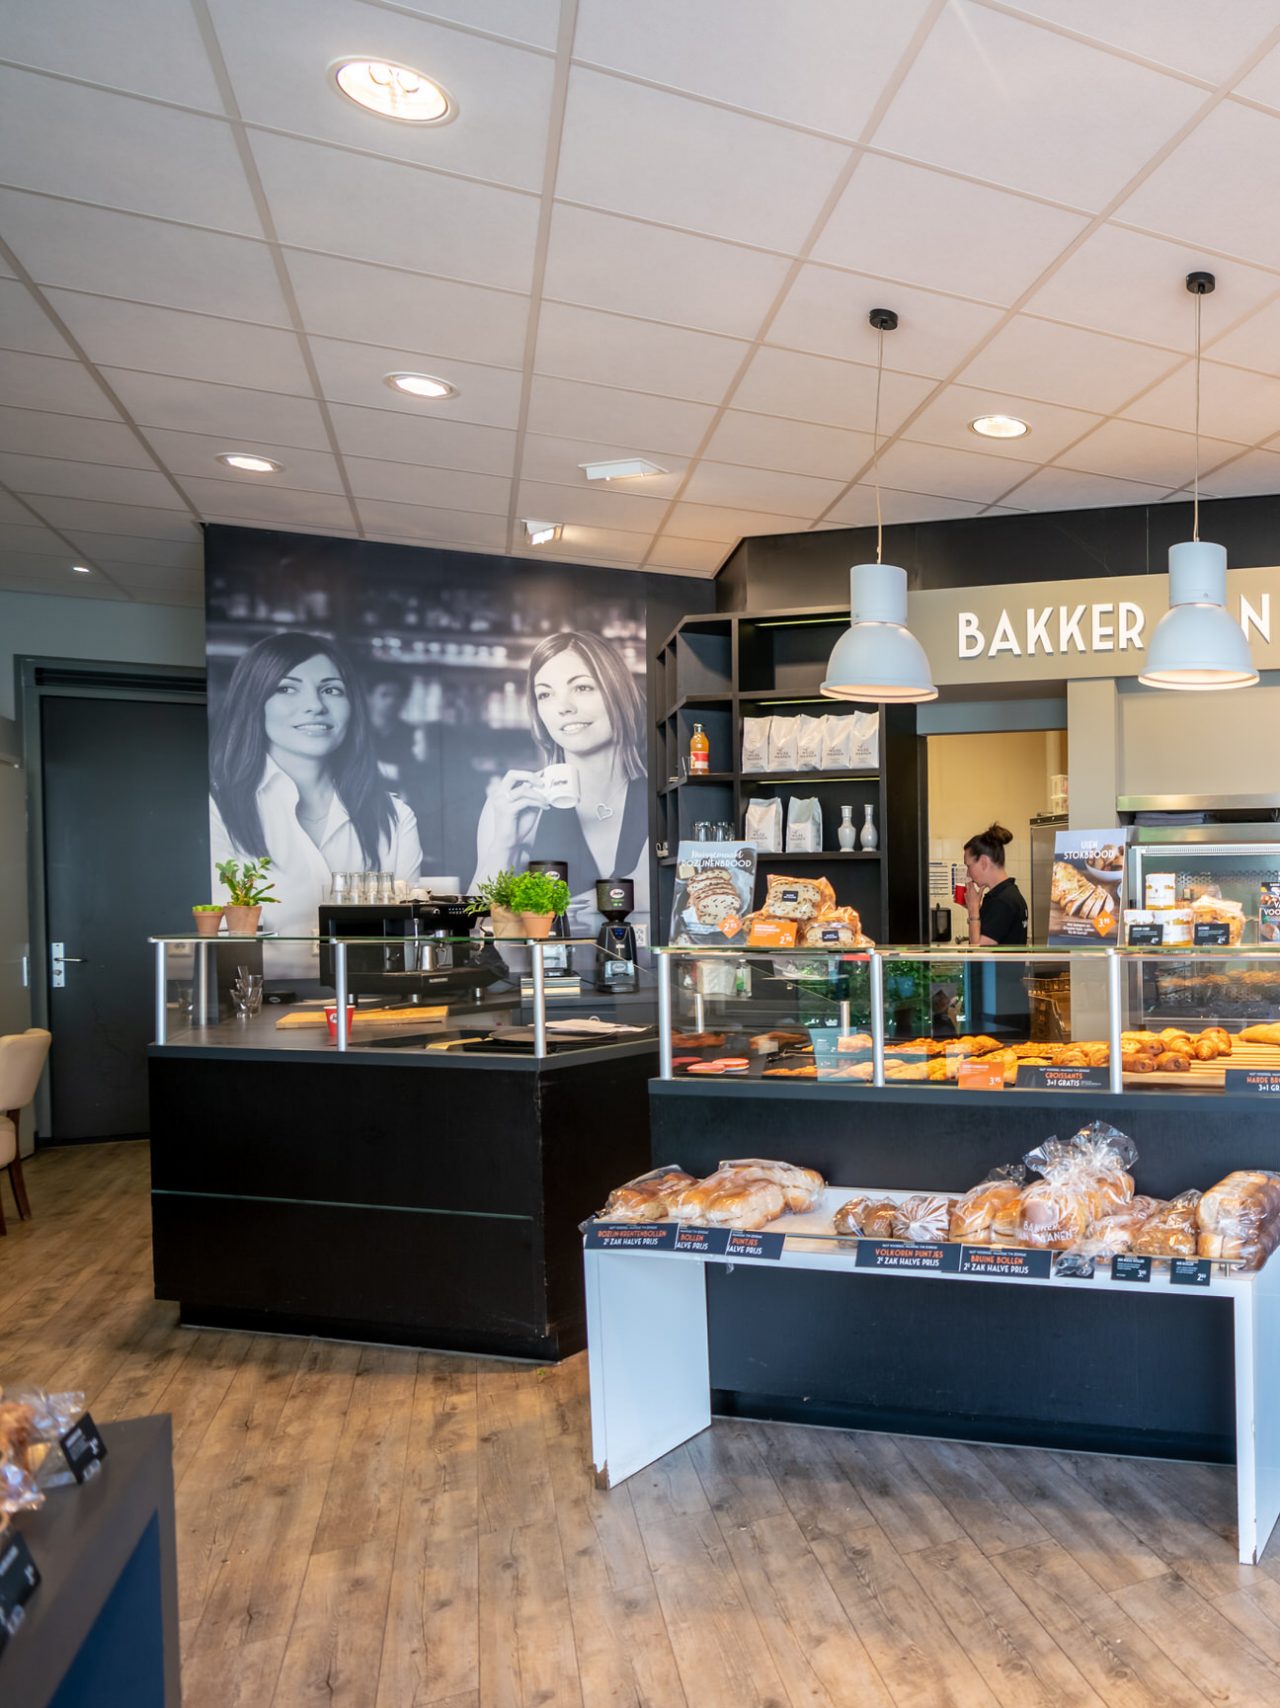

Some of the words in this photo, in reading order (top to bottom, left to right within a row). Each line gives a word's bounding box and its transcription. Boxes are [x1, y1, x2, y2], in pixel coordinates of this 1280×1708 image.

[957, 601, 1145, 658] BAKKER
[1064, 850, 1115, 860] STOKBROOD
[681, 857, 752, 868] ROZIJNENBROOD
[1044, 1072, 1083, 1080] CROISSANTS
[1058, 1079, 1080, 1087] GRATIS
[680, 1233, 704, 1241] BOLLEN
[732, 1237, 758, 1246] PUNTJES
[692, 1242, 709, 1250] PRIJS
[746, 1246, 762, 1255] PRIJS
[875, 1248, 914, 1257] VOLKOREN
[915, 1249, 944, 1258] PUNTJES
[884, 1257, 898, 1265] ZAK
[899, 1257, 921, 1266] HALVE
[922, 1258, 940, 1267] PRIJS
[970, 1255, 995, 1264] BRUINE
[996, 1256, 1024, 1265] BOLLEN
[971, 1263, 986, 1271] ZAK
[987, 1264, 1009, 1273] HALVE
[1010, 1265, 1029, 1274] PRIJS
